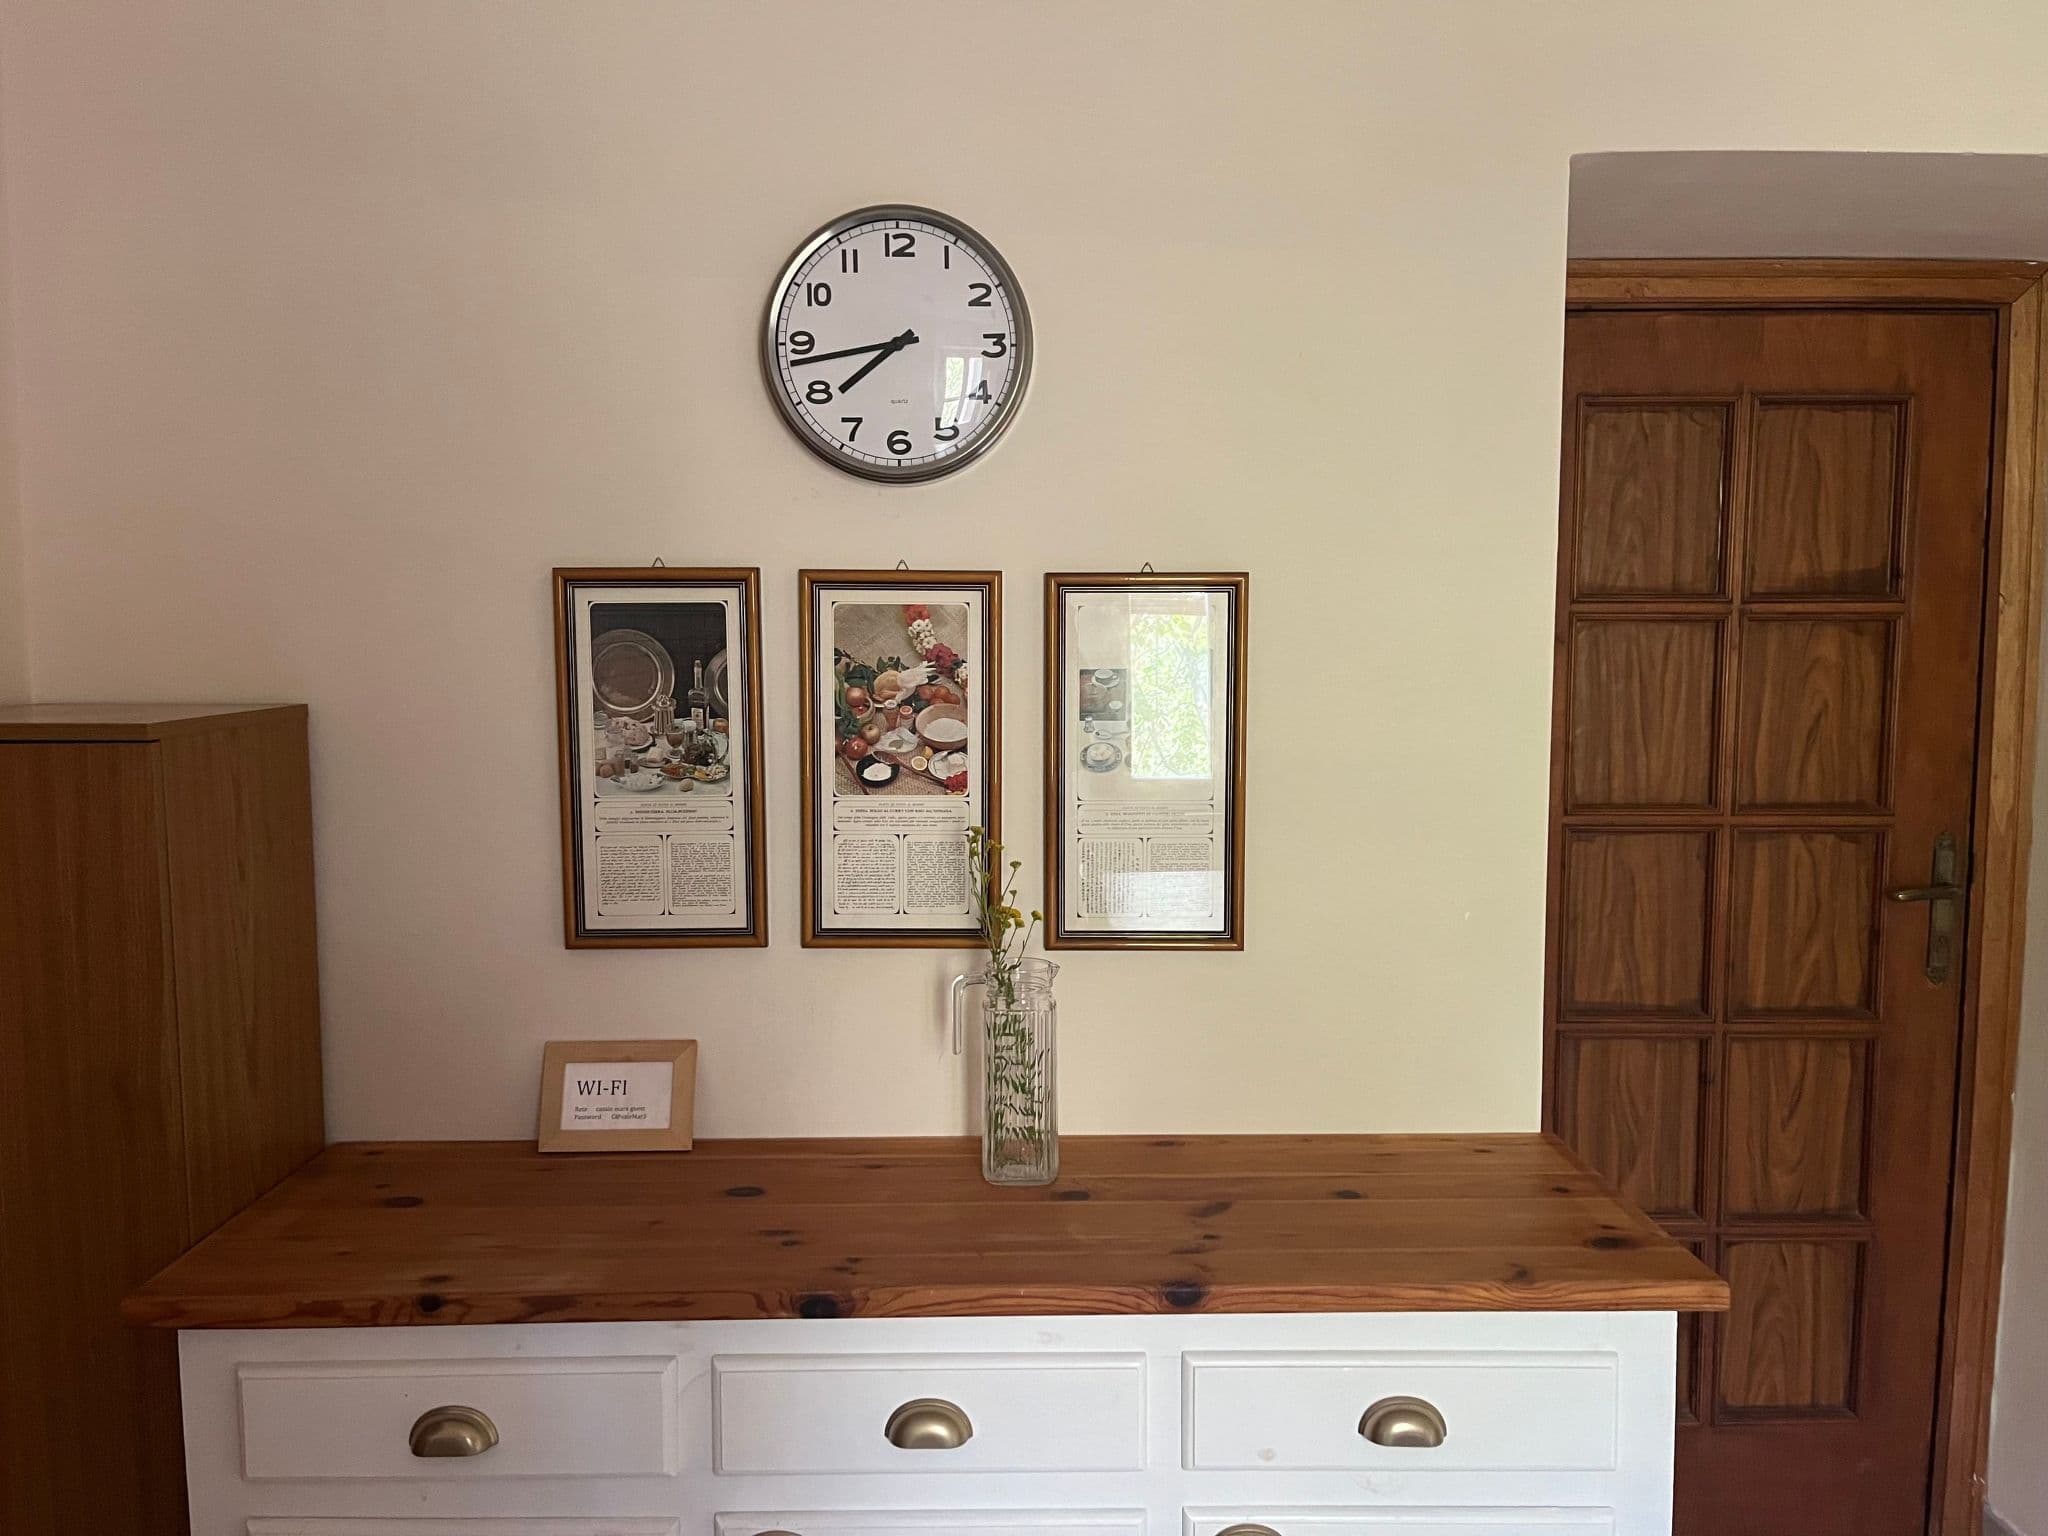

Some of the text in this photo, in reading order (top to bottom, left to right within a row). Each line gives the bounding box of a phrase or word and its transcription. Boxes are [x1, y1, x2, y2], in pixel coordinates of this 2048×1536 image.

[884, 233, 916, 257] 12
[943, 245, 950, 269] 1
[841, 248, 859, 273] 11
[806, 282, 832, 306] 10
[968, 282, 992, 307] 2
[789, 330, 815, 355] 9
[981, 333, 1007, 358] 3
[806, 380, 833, 404] 8
[968, 380, 992, 404] 4
[841, 417, 863, 441] 7
[933, 417, 960, 441] 5
[886, 430, 912, 455] 6
[577, 1079, 627, 1096] WI-FI
